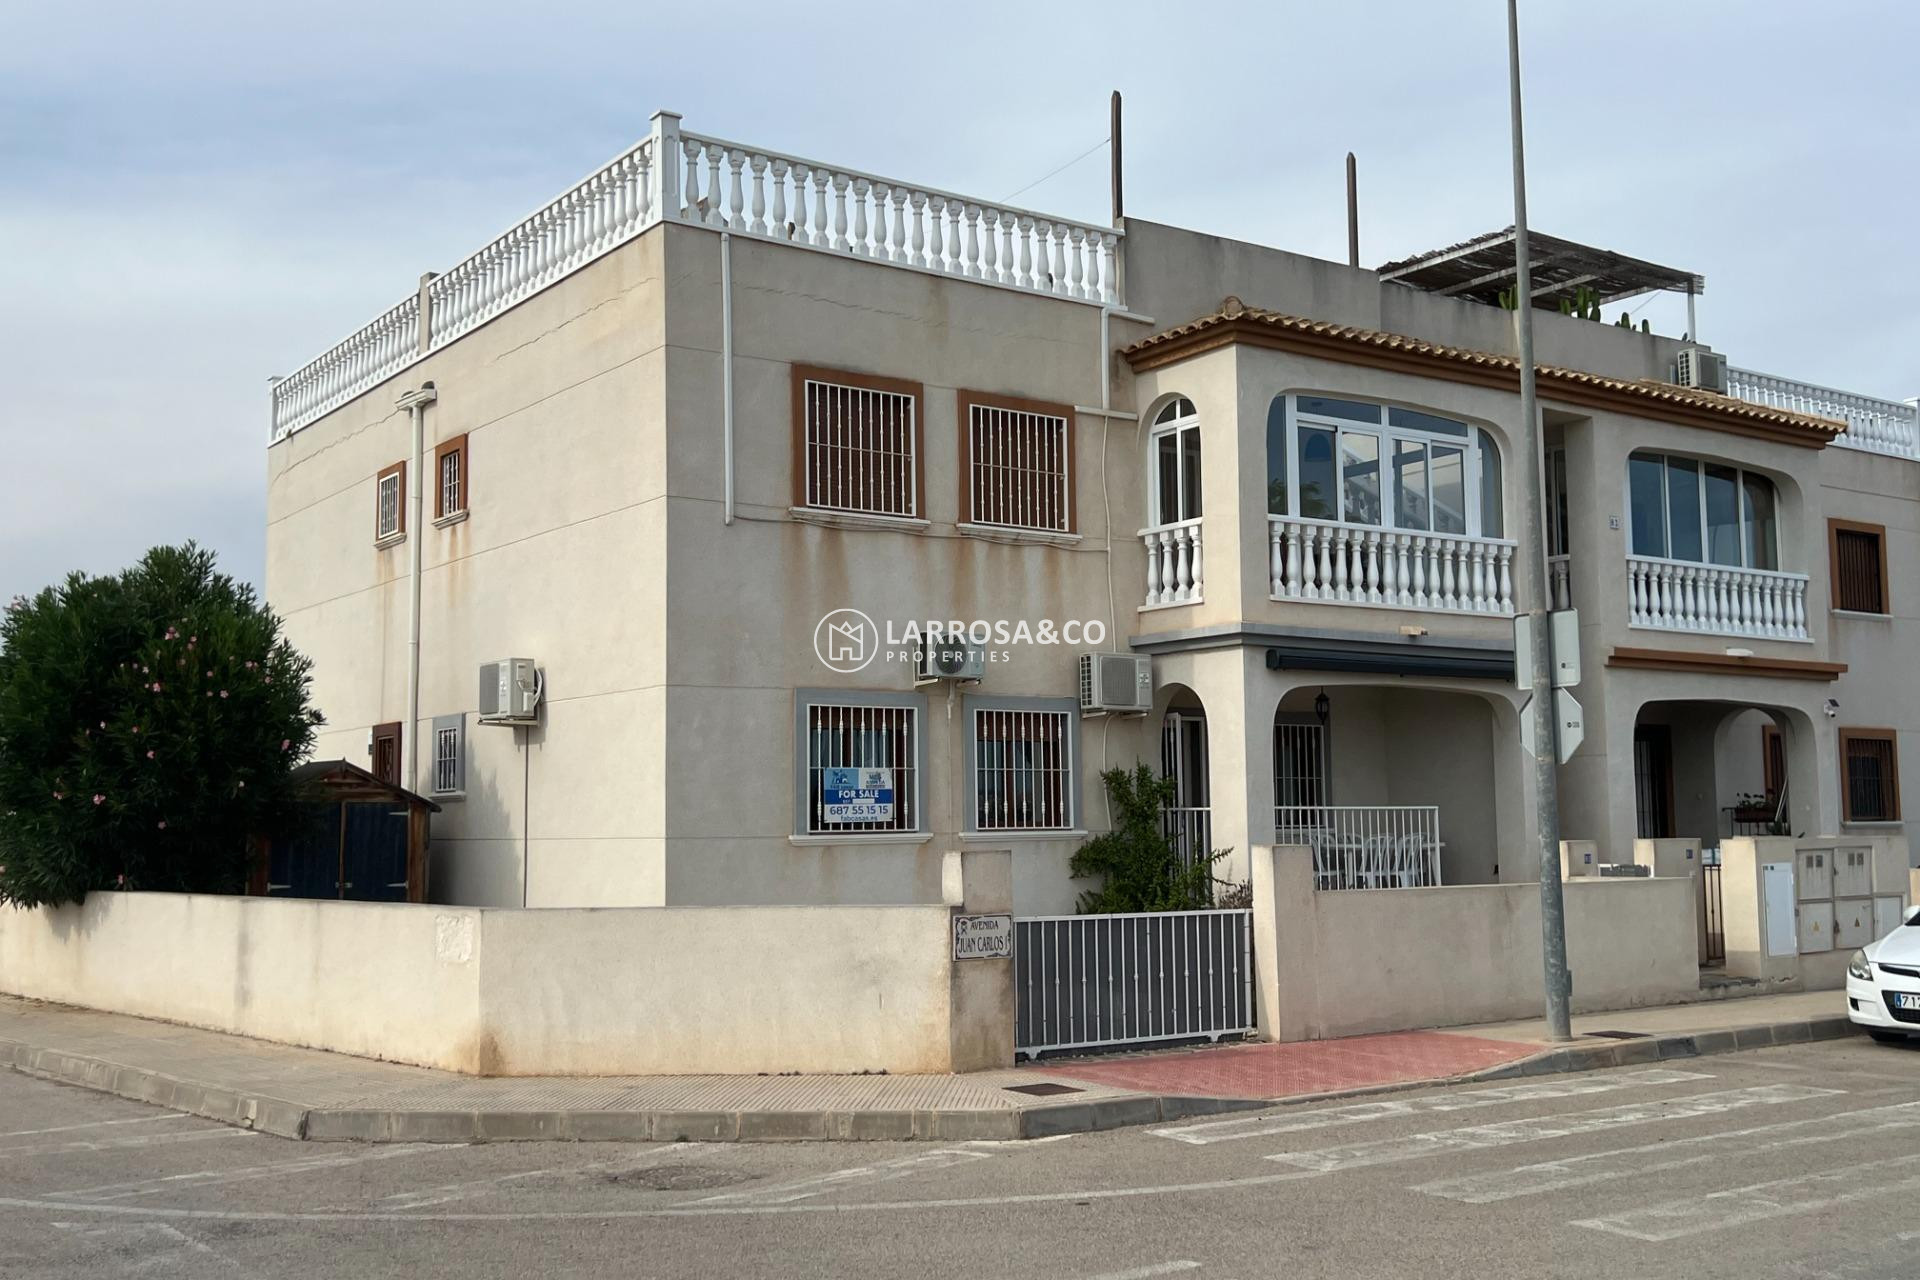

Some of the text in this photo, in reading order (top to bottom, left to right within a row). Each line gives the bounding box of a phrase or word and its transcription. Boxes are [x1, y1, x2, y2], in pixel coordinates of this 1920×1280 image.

[838, 790, 879, 799] FOR SALE
[829, 805, 889, 815] 687 55 15 15
[970, 919, 999, 931] AVENIDA
[959, 937, 976, 953] JUAN
[977, 935, 1004, 952] CARLOS
